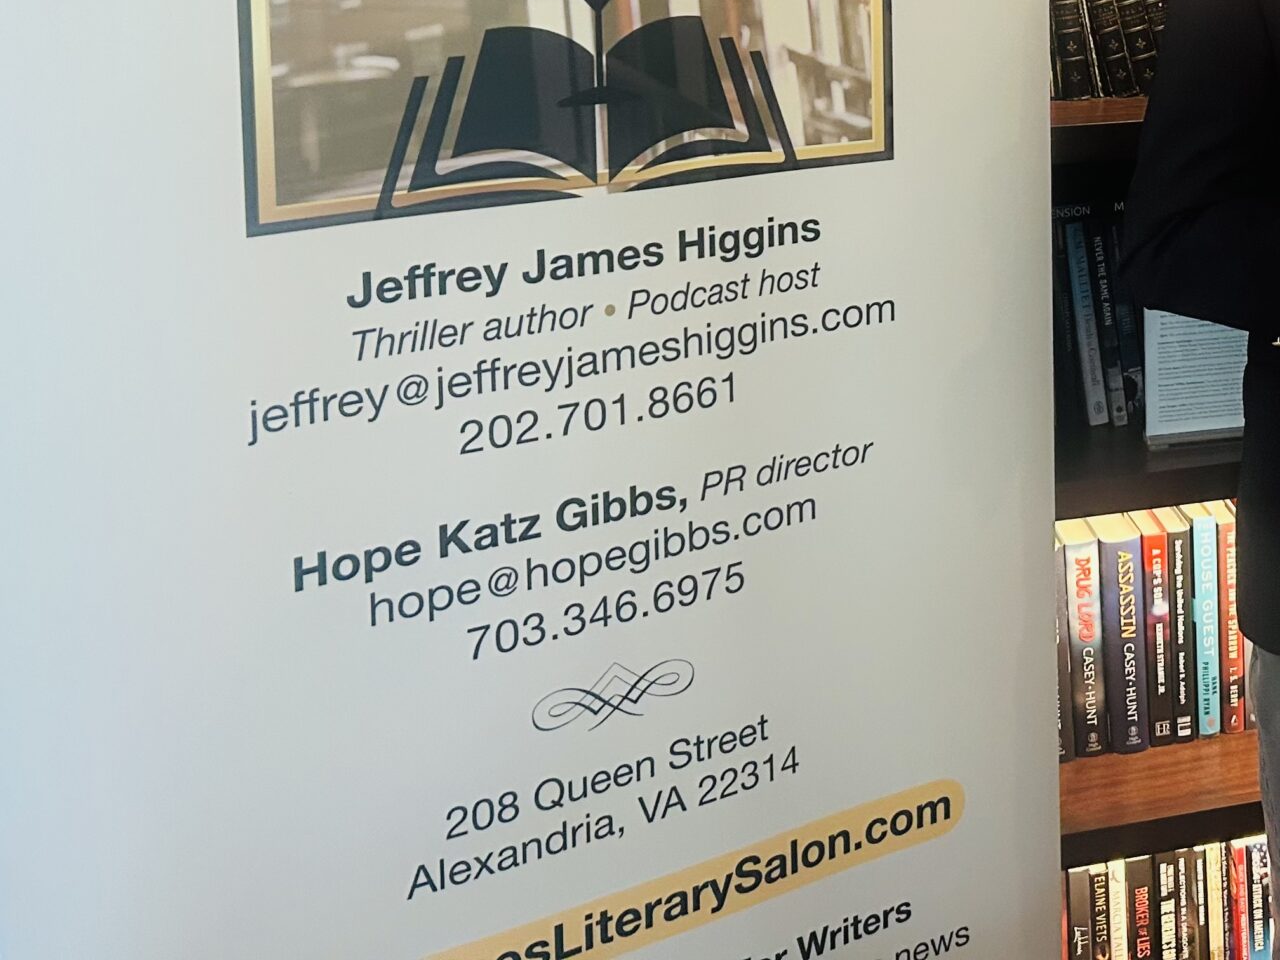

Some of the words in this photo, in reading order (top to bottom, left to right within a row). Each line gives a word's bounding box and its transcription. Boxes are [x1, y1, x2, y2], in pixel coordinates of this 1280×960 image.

[347, 263, 508, 308] Jeffrey
[523, 243, 663, 283] James
[679, 217, 820, 262] Higgins
[353, 319, 473, 361] Thriller
[484, 304, 593, 341] author
[628, 273, 750, 319] Podcast
[759, 262, 820, 296] host
[248, 298, 894, 444] jeffrey@jeffreyjameshiggins.com
[461, 373, 733, 454] 202.701.8661
[294, 540, 421, 592] Hope
[439, 514, 541, 558] Katz
[556, 486, 686, 531] Gibbs,
[701, 465, 746, 501] PR
[757, 442, 873, 486] director
[364, 495, 815, 627] hope@hopegibbs.com
[1075, 557, 1092, 598] DRUG
[1200, 532, 1213, 595] HOUSE
[467, 561, 744, 660] 703.346.6975
[1078, 603, 1094, 643] LORD
[1118, 551, 1136, 638] ASSASSIN
[1202, 599, 1215, 656] GUEST
[1083, 647, 1095, 685] CASEY
[1124, 643, 1136, 685] CASEY
[1085, 691, 1097, 726] HUNT
[1125, 687, 1138, 722] HUNT
[447, 792, 519, 840] 208
[535, 757, 657, 810] Queen
[669, 715, 774, 768] Street
[408, 815, 624, 900] Alexandria,
[638, 786, 687, 823] VA
[693, 746, 799, 806] 22314
[1094, 876, 1105, 912] ELAINE
[797, 902, 911, 960] Writers
[1096, 913, 1107, 943] VIETS
